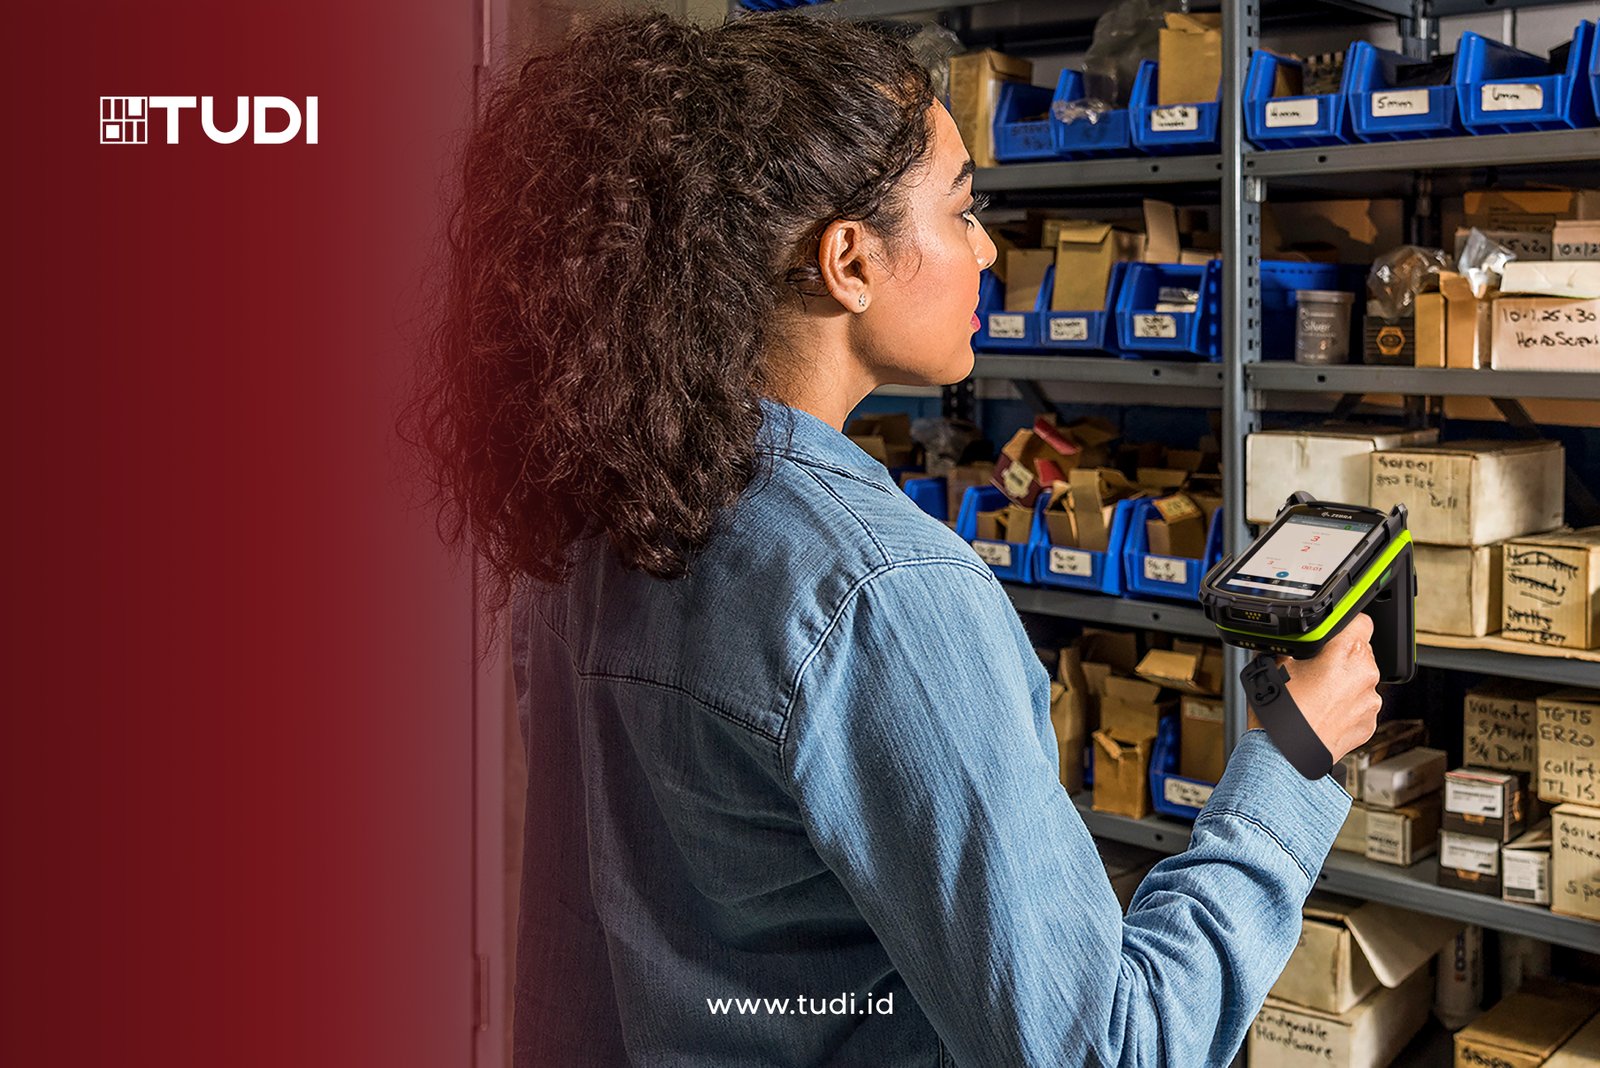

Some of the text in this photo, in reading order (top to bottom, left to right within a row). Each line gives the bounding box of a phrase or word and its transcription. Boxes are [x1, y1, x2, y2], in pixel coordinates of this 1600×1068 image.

[1376, 97, 1414, 109] 5mm
[1311, 535, 1320, 543] 3
[1544, 760, 1600, 780] Collet
[1256, 1022, 1333, 1060] Hardware
